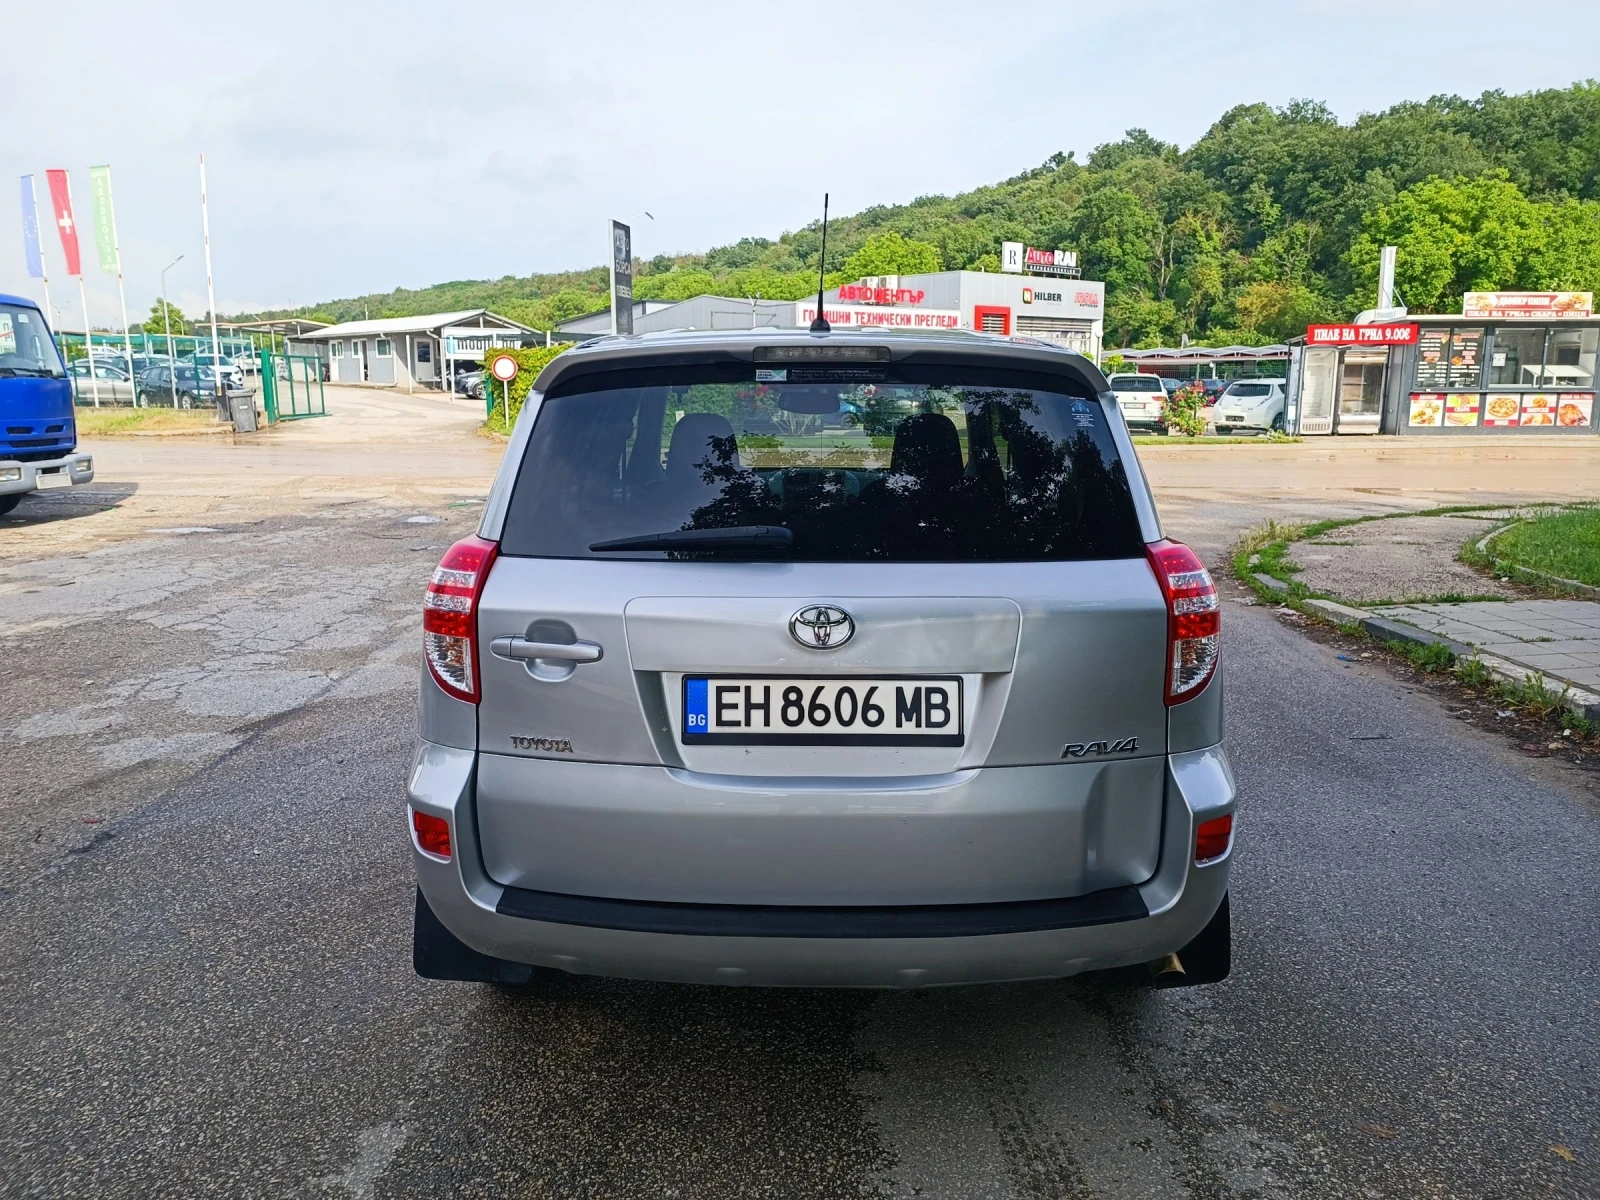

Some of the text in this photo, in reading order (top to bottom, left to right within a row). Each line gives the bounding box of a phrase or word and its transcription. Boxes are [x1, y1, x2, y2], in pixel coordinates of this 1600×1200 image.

[1009, 249, 1017, 265] R
[838, 285, 925, 304] АВТОЦЕНТЪР
[1034, 292, 1062, 302] HILBER
[803, 309, 958, 329] ГОИШНИ ТЕХНИЧЕСКИ ПРЕГЛЕДИ
[1313, 328, 1340, 341] ПИЛЕ
[1342, 328, 1355, 341] НА
[1358, 328, 1383, 341] ГРИЛ
[1385, 328, 1411, 340] 9.00€
[688, 685, 951, 728] BG EH 8606 MB
[510, 735, 574, 753] TOYOTA
[1060, 736, 1140, 759] RAV4
